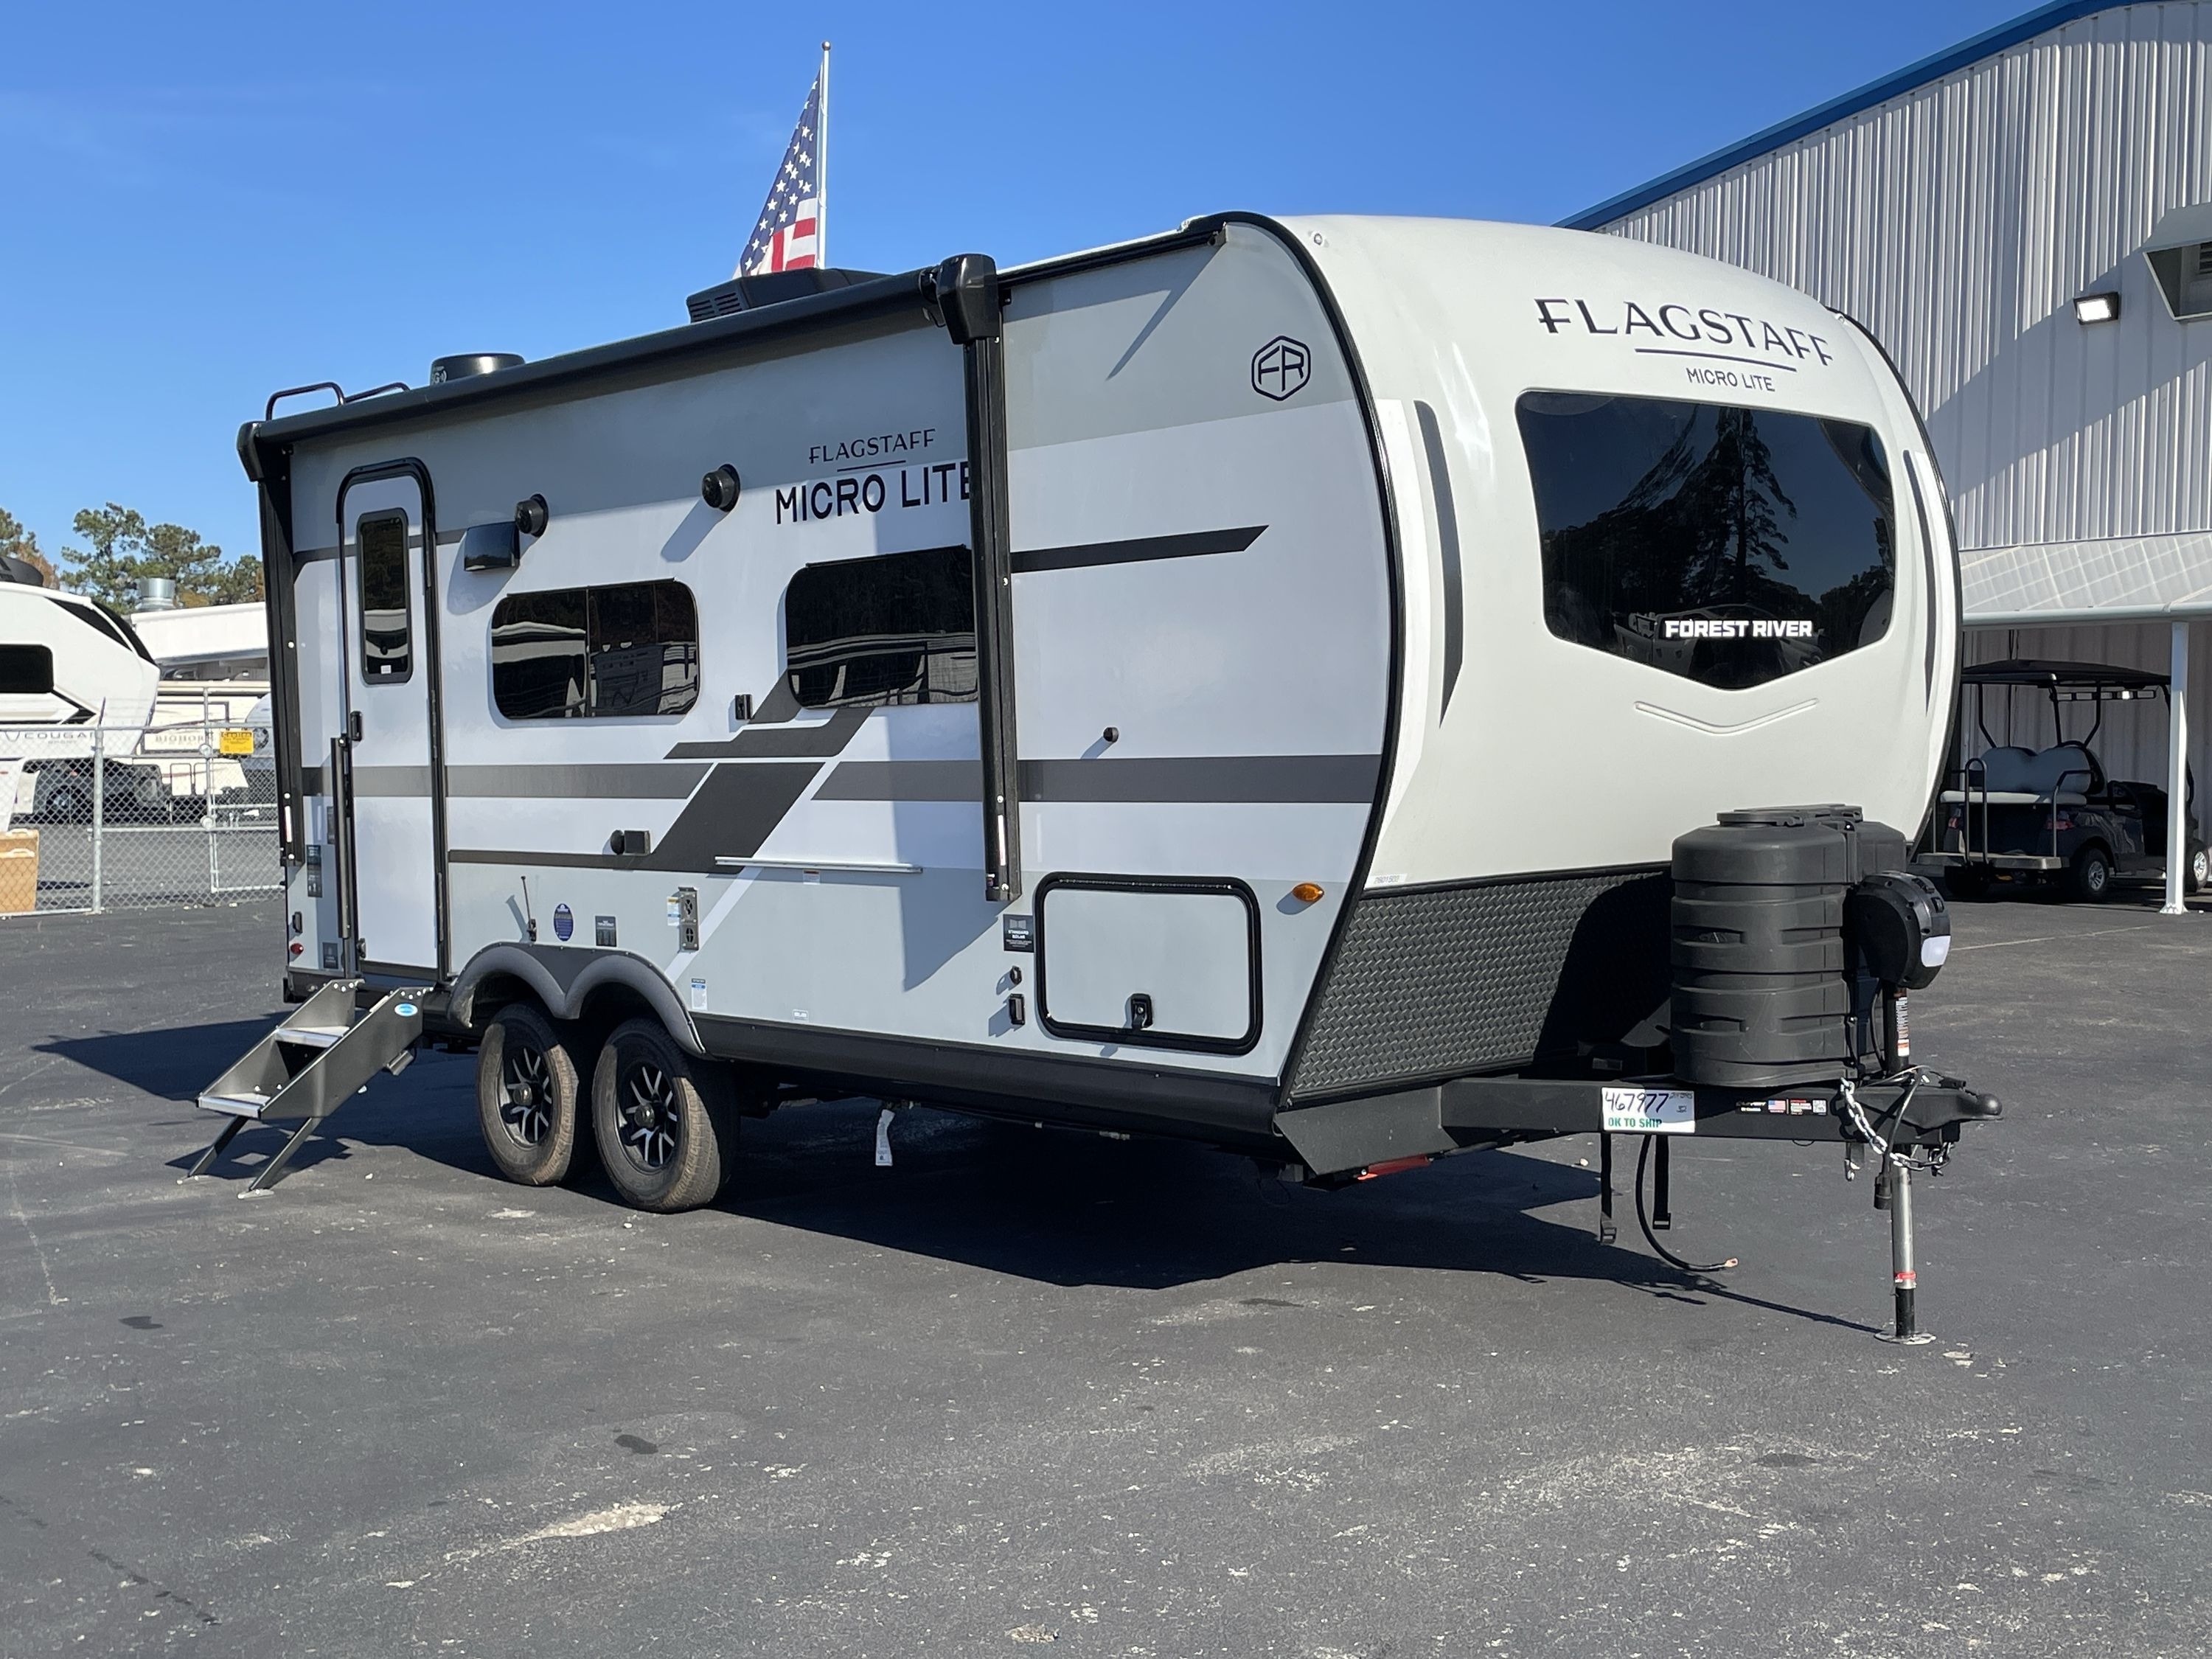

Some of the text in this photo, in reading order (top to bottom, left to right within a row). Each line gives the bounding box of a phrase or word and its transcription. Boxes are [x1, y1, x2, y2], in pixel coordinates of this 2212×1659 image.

[1534, 298, 1834, 366] FLAGSTAFF
[1686, 367, 1775, 392] MICRO LITE
[808, 428, 936, 464] FLAGSTAFF
[776, 473, 886, 524] MICRO
[1664, 619, 1813, 638] FOREST RIVER
[1604, 1091, 1669, 1113] 467977
[1608, 1117, 1663, 1127] OK TO SHIP
